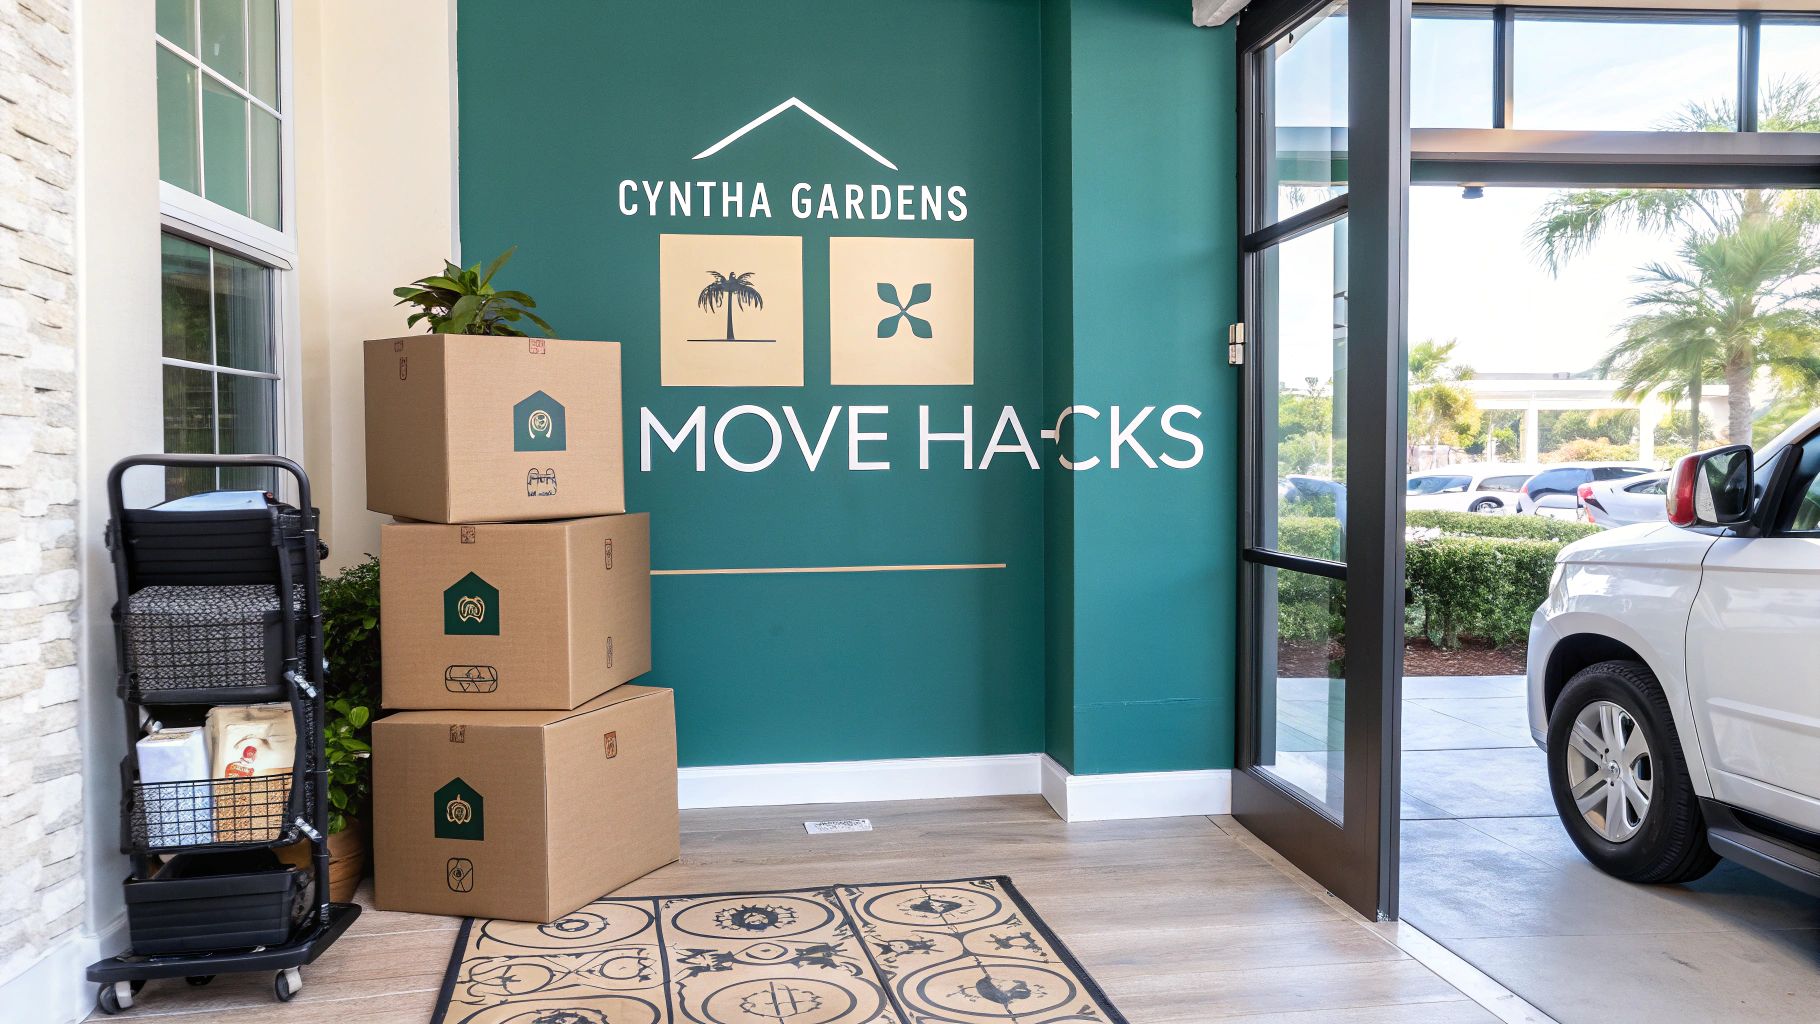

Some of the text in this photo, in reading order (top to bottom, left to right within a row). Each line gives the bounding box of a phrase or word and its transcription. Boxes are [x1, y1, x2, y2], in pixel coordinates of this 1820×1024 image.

[617, 179, 969, 222] CYNTHA GARDENS
[640, 404, 891, 472] MOVE
